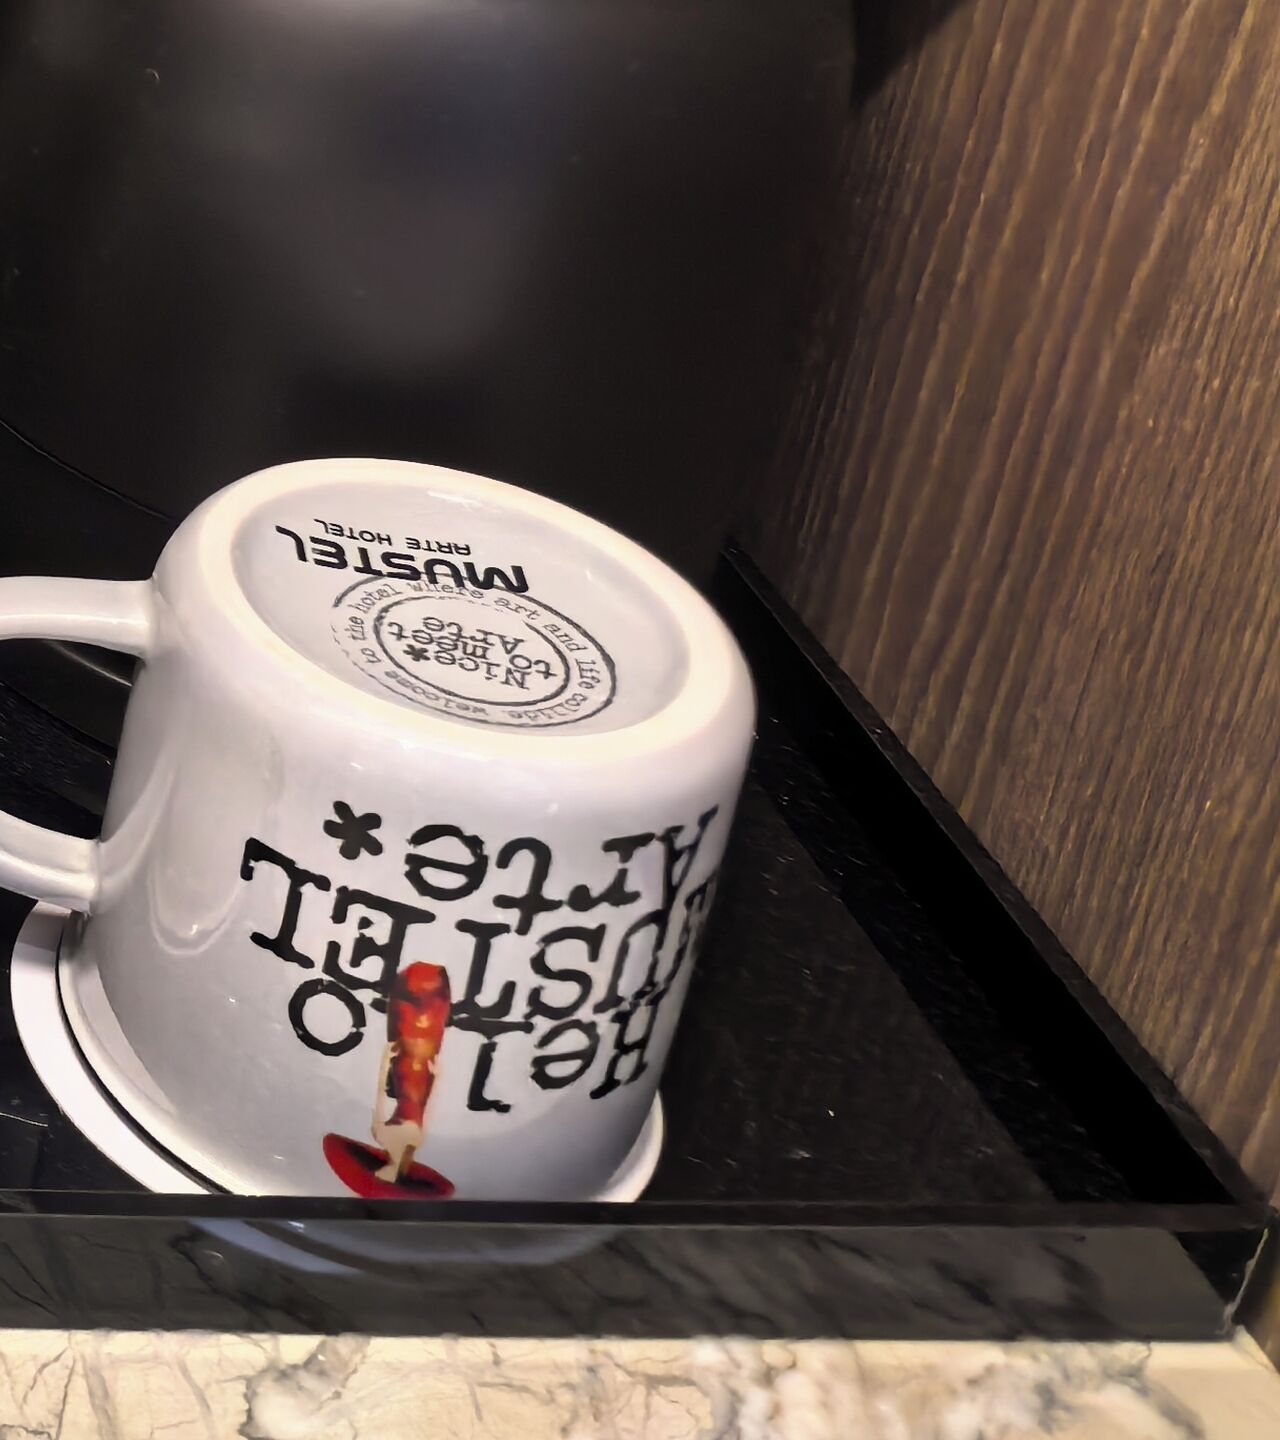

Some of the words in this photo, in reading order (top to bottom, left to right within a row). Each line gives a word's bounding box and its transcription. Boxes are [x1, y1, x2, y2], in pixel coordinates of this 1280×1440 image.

[313, 518, 392, 546] HOTEL
[275, 525, 529, 594] MUSTEL
[406, 536, 471, 557] ARTE
